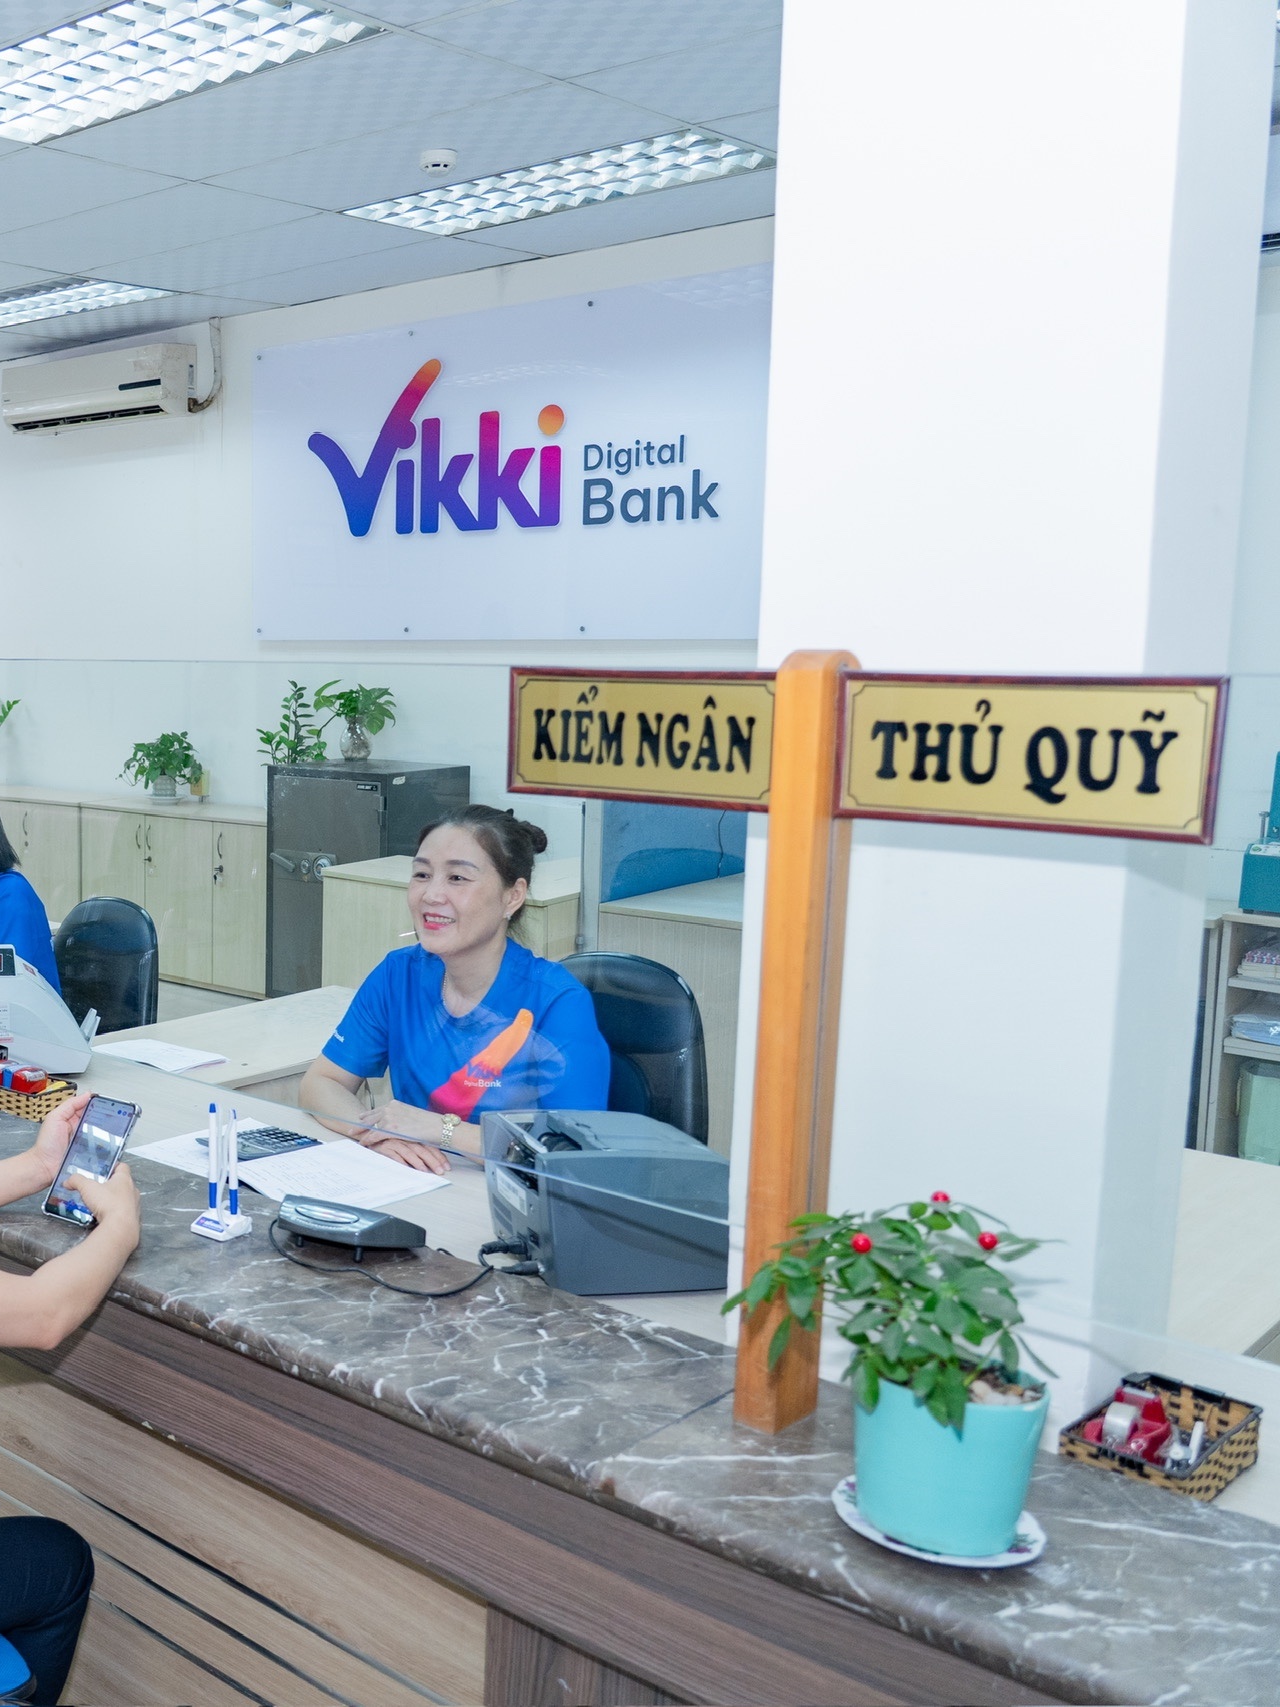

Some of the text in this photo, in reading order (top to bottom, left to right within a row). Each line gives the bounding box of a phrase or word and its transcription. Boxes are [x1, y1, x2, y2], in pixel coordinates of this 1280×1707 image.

[307, 358, 564, 537] Vikki
[584, 435, 686, 476] Digital
[582, 469, 719, 525] Bank
[532, 685, 756, 775] KIỂM NGÂN
[871, 699, 1179, 804] THỦ QUỸ
[478, 1079, 502, 1088] Bank
